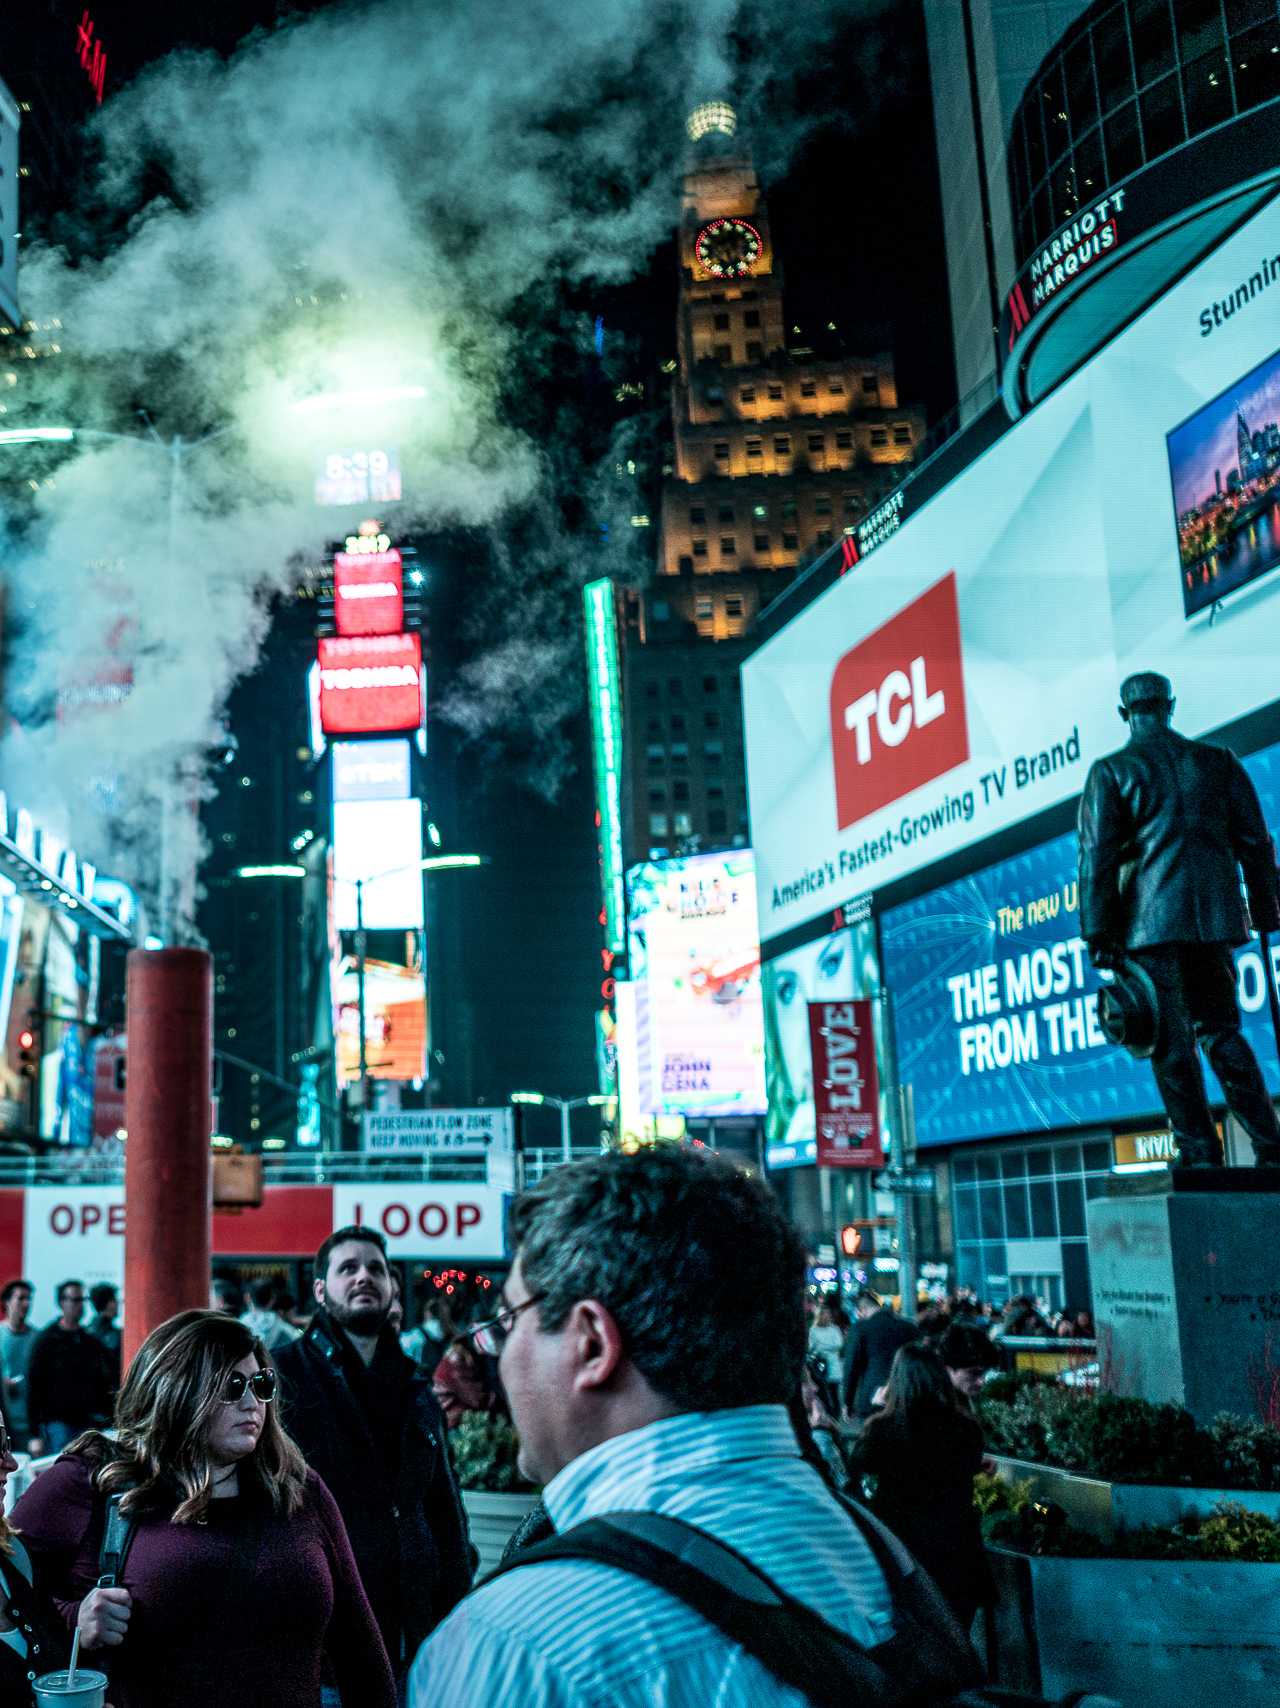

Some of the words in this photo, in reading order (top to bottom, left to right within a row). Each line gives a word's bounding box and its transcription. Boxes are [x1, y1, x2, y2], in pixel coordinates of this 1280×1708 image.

[1030, 189, 1126, 282] MARRIOTT
[1033, 225, 1115, 306] MARQUIS
[859, 491, 904, 541] MARRIOTT
[320, 664, 419, 690] TOSHIBA
[844, 655, 946, 766] TCL
[772, 861, 835, 911] America's
[839, 789, 976, 876] Fastest-Growing
[980, 765, 1007, 804] TV
[1014, 725, 1081, 790] Brand
[997, 903, 1024, 936] The
[1027, 892, 1060, 925] new
[946, 963, 1002, 1023] THE
[1003, 936, 1089, 1009] MOST
[823, 1003, 861, 1111] LOVE
[958, 1009, 1040, 1076] FROM
[1041, 992, 1108, 1056] THE
[371, 1115, 433, 1130] PEDESTRIAN
[435, 1114, 463, 1129] FLOW
[466, 1113, 493, 1129] ZONE
[371, 1133, 396, 1148] KEEP
[398, 1132, 439, 1148] MOVING
